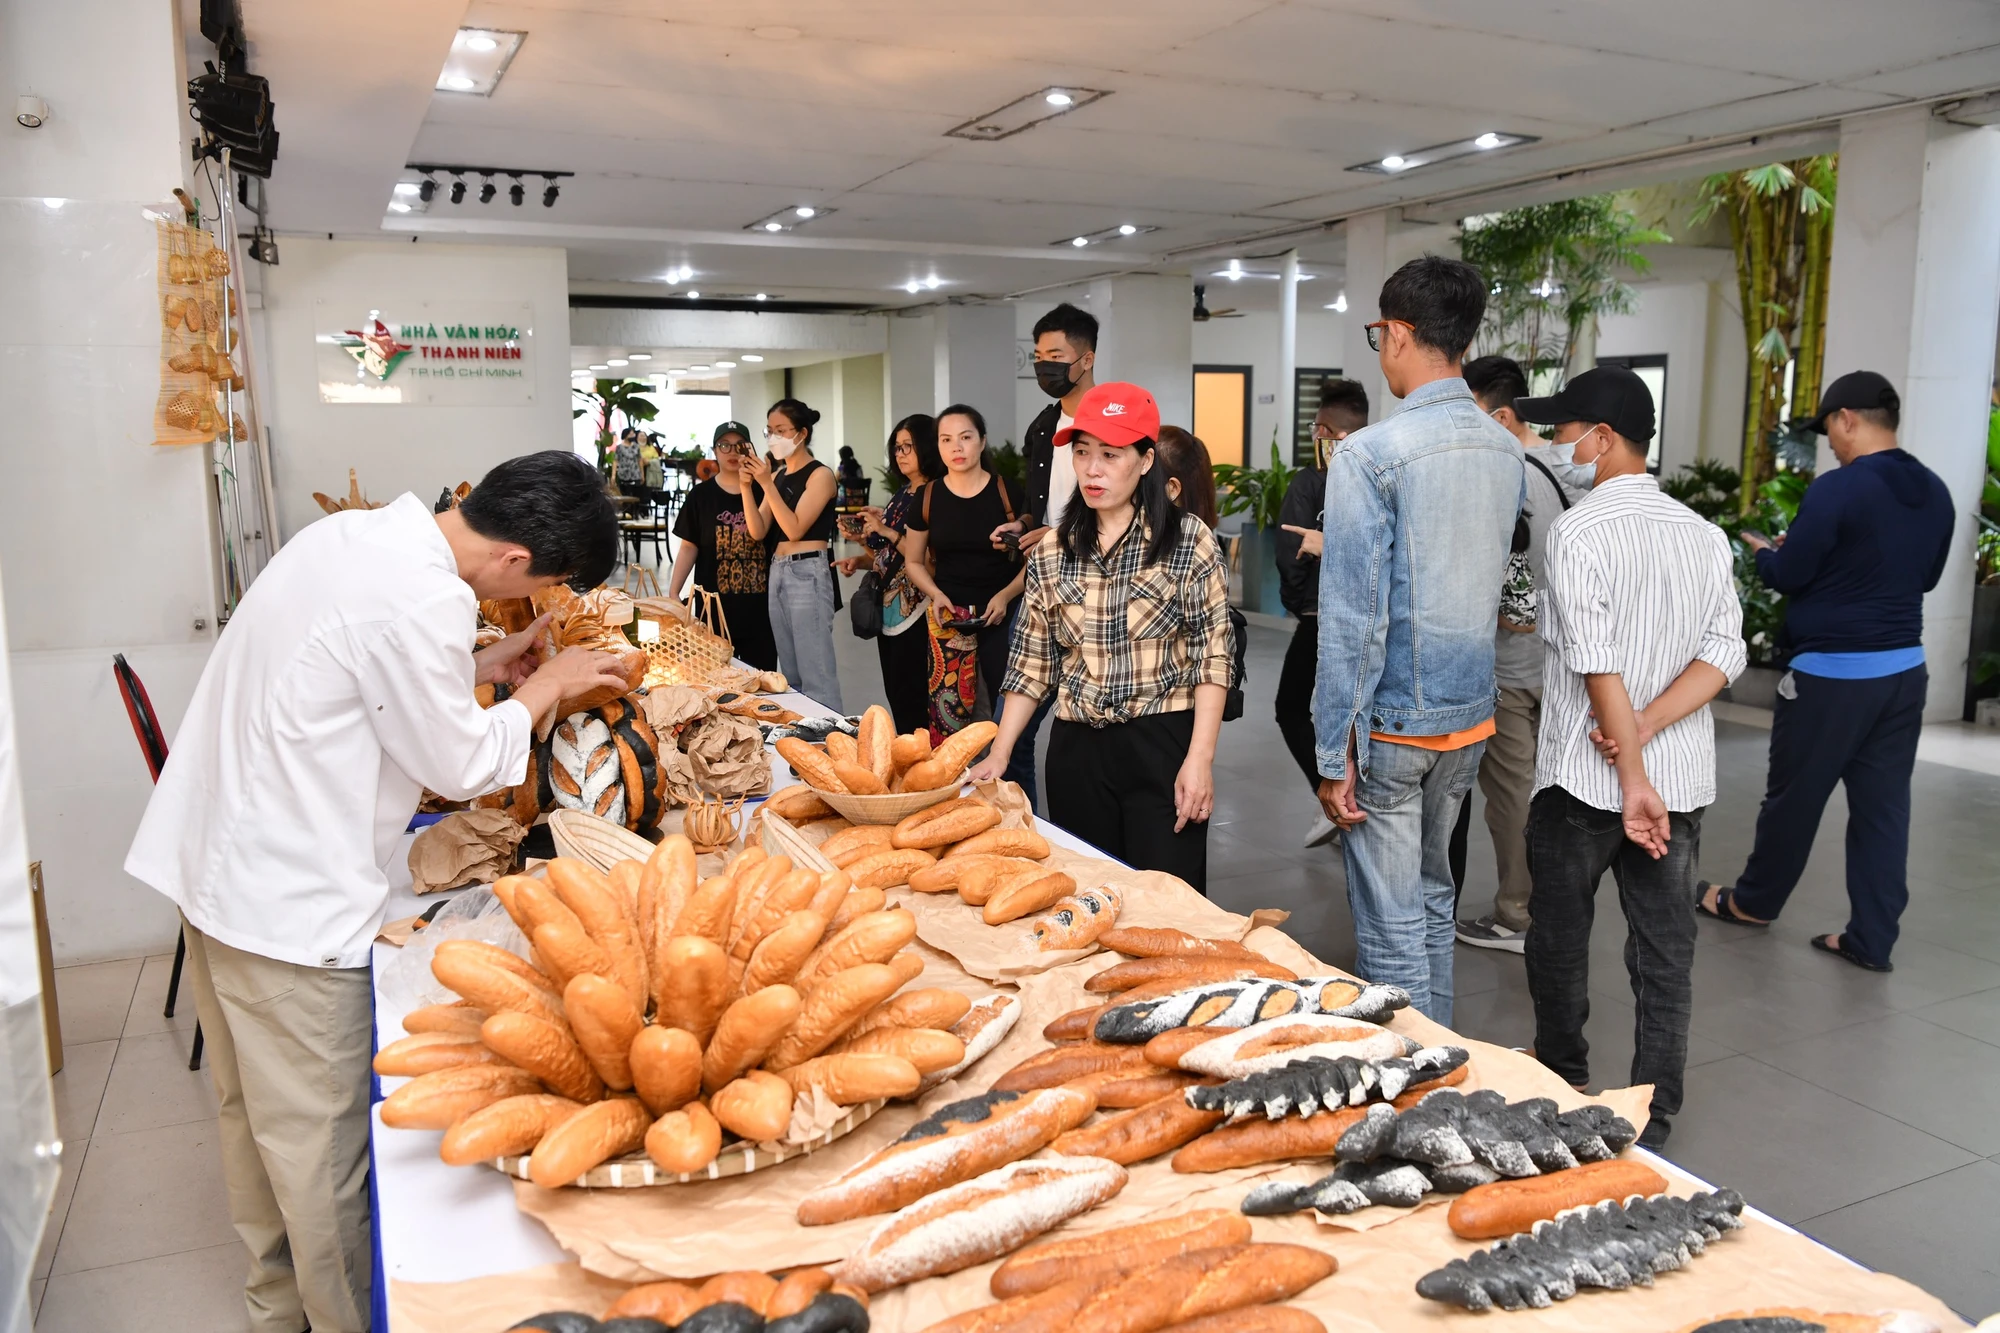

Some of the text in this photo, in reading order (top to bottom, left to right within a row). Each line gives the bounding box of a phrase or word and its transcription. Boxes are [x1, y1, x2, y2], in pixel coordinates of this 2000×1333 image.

[401, 322, 519, 339] NHÀ VĂN HÓA
[420, 346, 480, 359] THANH
[459, 366, 482, 377] CHÍ
[486, 369, 522, 377] MINH
[1107, 402, 1125, 413] NIKE
